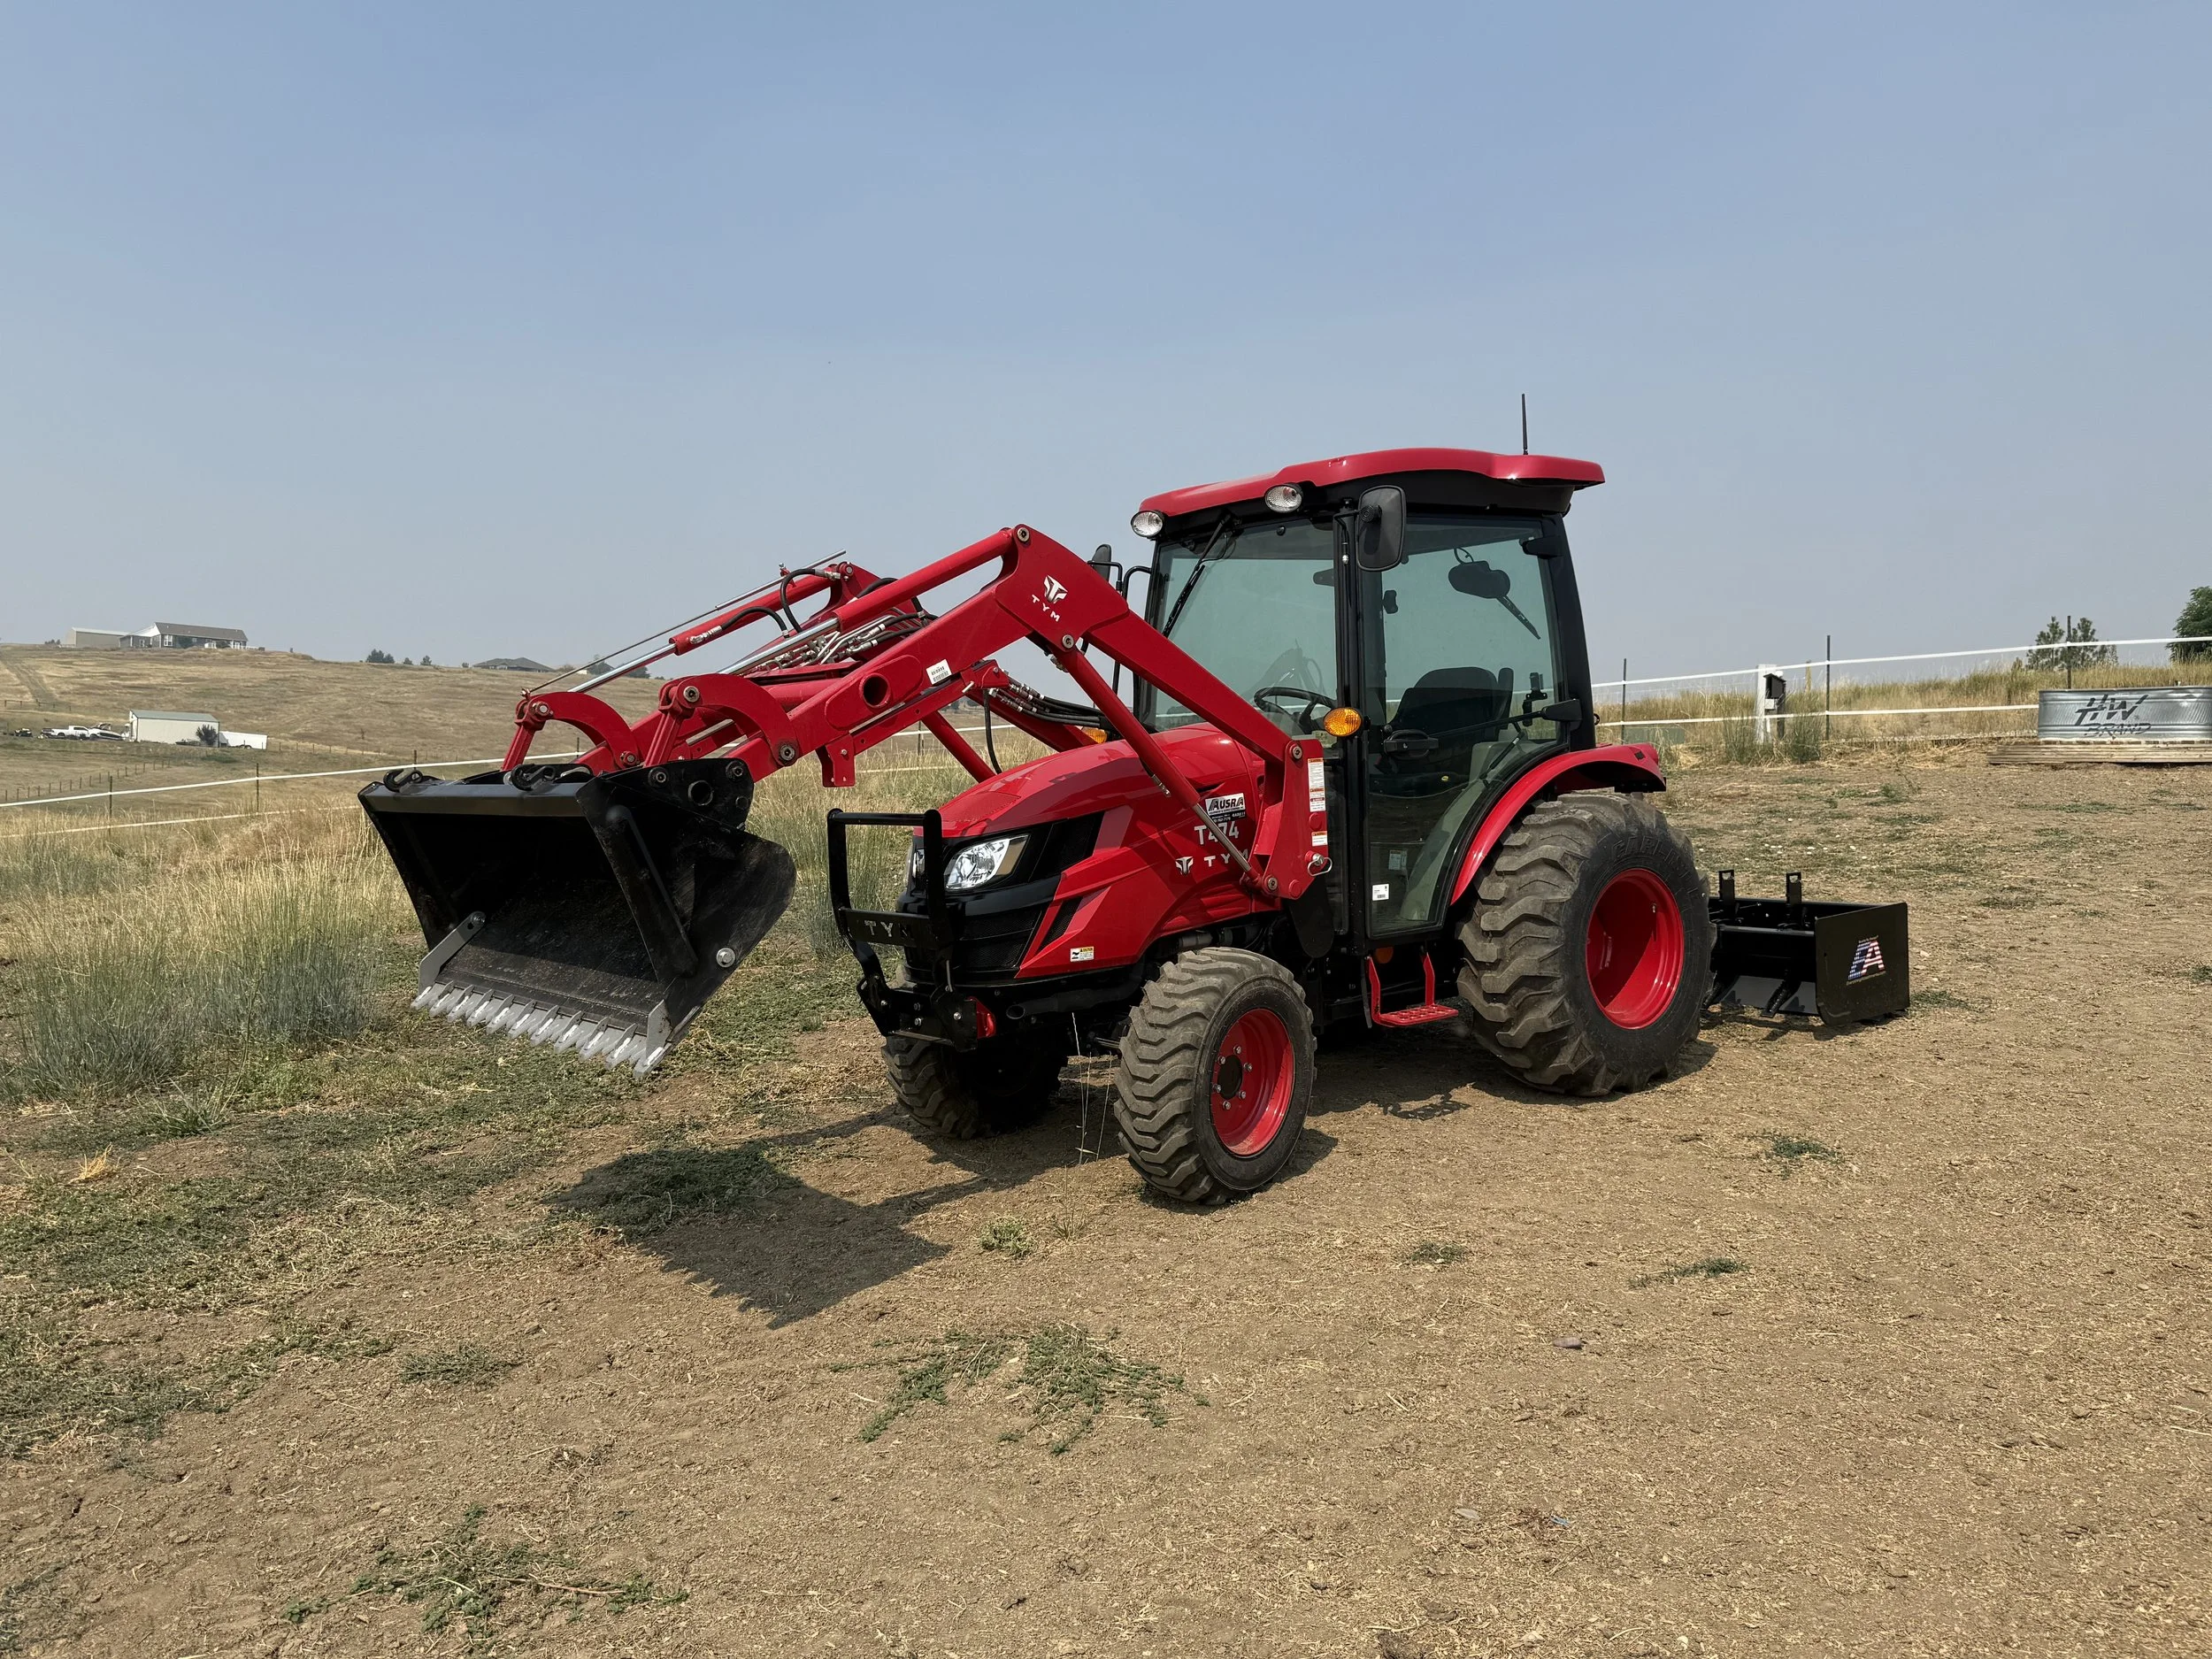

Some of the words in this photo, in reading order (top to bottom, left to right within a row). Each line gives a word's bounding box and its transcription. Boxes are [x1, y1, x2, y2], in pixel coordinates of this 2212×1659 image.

[1032, 594, 1061, 622] TYM
[2084, 723, 2152, 737] BRAND
[1208, 796, 1244, 811] AUSRA
